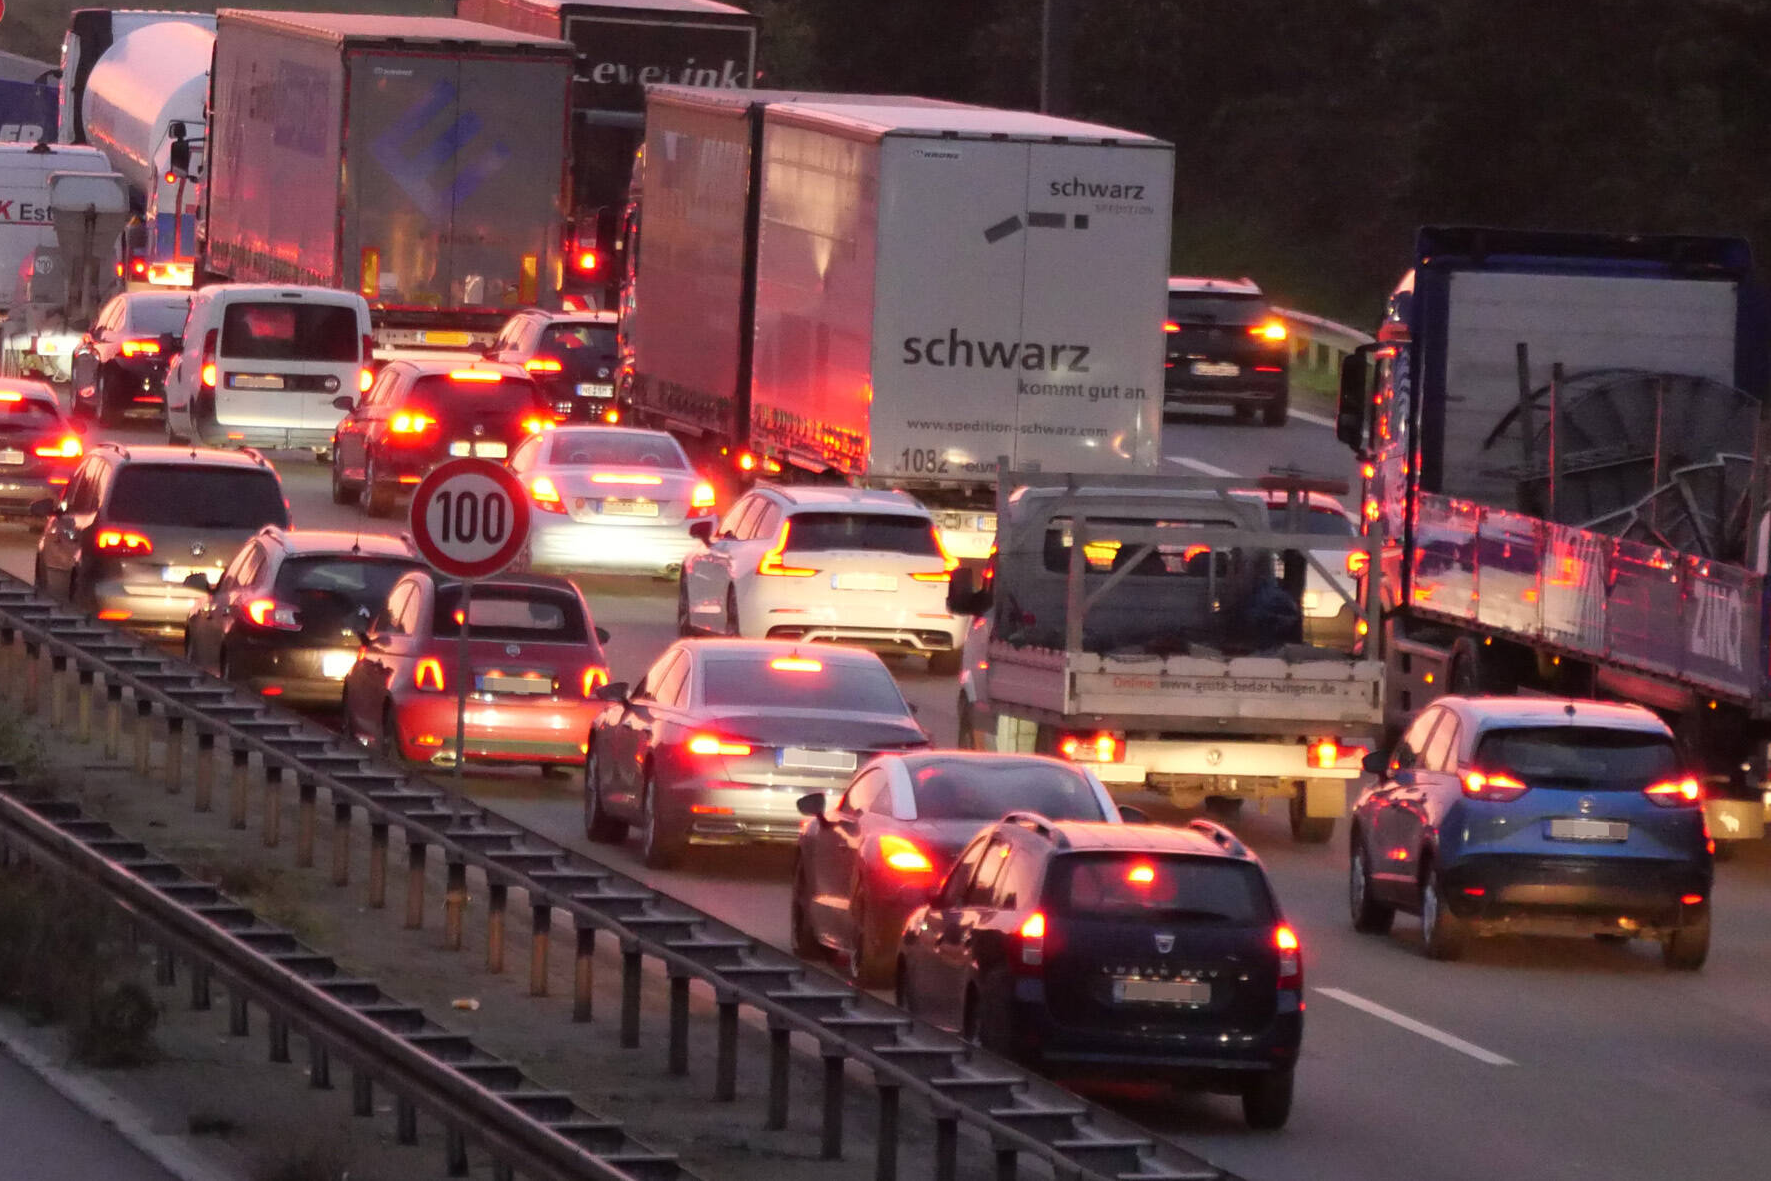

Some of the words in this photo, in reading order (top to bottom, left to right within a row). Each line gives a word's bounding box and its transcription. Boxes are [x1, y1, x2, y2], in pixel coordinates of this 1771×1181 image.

[1049, 177, 1145, 201] schwarz
[902, 327, 1091, 373] schwarz
[1017, 378, 1085, 398] kommt
[1088, 383, 1120, 403] gut
[1124, 385, 1147, 400] an
[907, 418, 1109, 438] www.spedition-schwarz.com
[435, 491, 506, 546] 100
